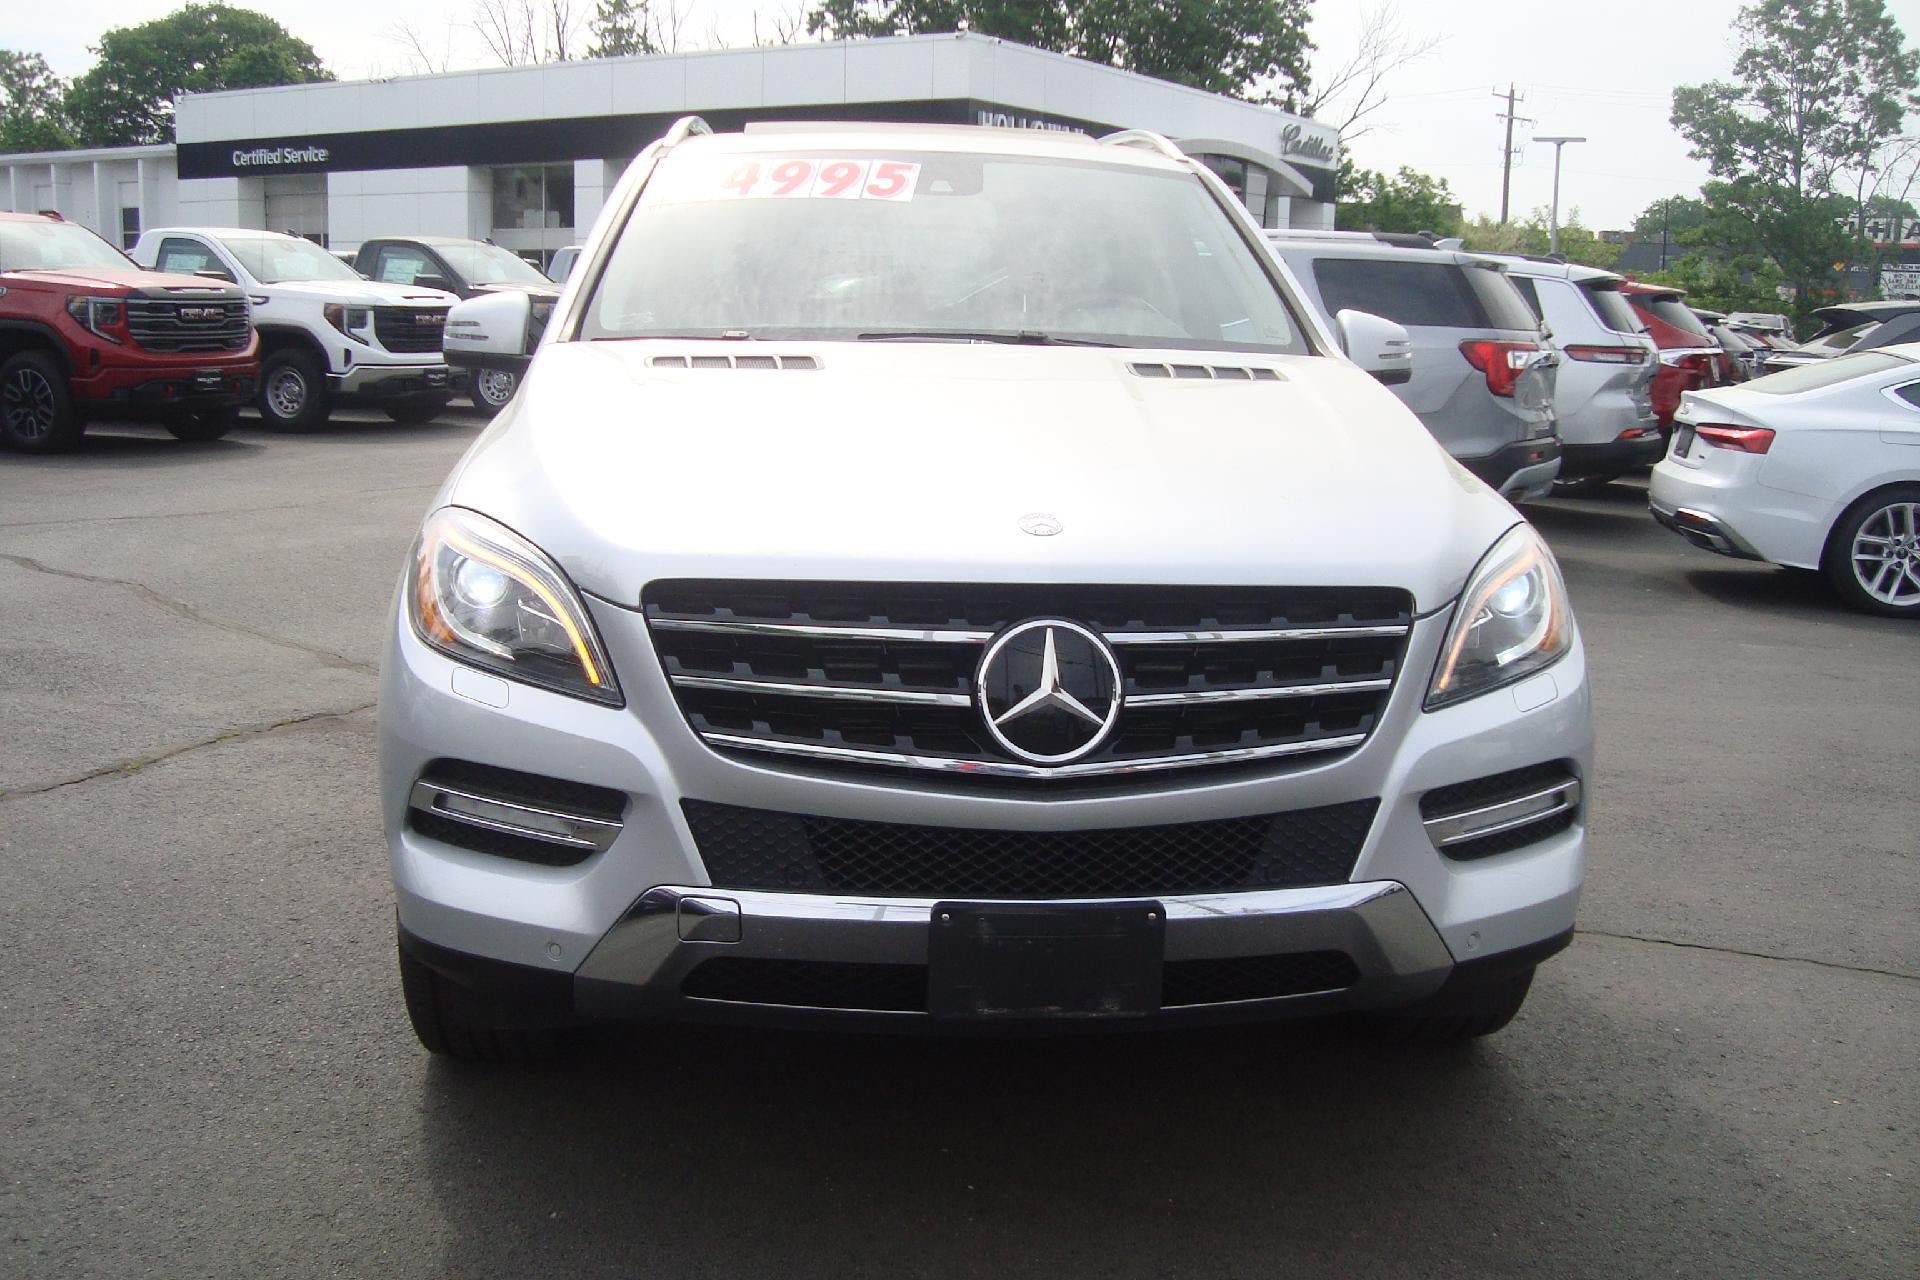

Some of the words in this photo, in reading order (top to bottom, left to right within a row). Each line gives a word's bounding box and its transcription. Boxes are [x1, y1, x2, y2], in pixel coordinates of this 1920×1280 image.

[232, 147, 281, 167] Certified
[283, 146, 326, 164] Service
[1281, 124, 1334, 161] Cadillac
[720, 160, 914, 197] 4995
[181, 308, 224, 320] GMC
